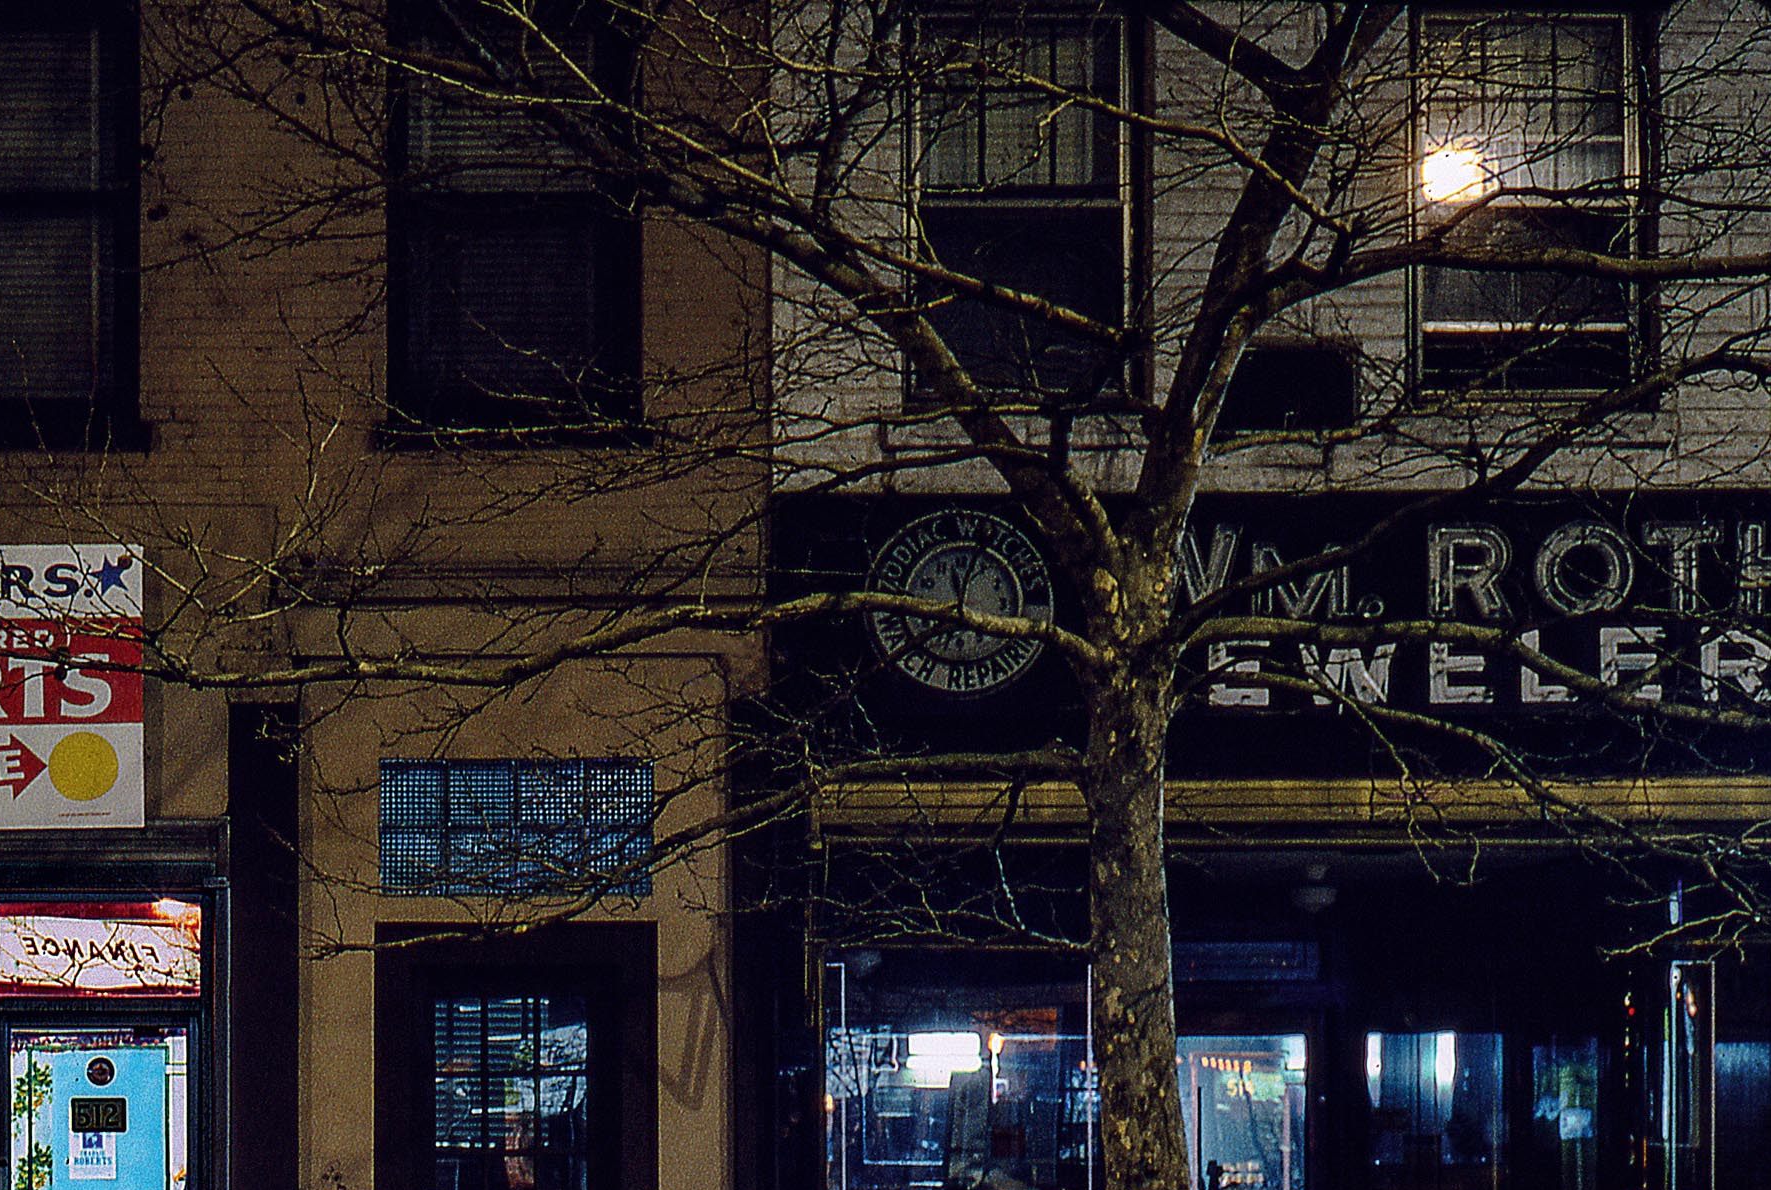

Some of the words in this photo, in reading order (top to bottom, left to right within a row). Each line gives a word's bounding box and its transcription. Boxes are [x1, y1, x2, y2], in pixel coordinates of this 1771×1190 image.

[956, 517, 1045, 590] WTCHES
[872, 611, 932, 685] WACH
[1208, 627, 1771, 705] EWELER
[77, 1103, 120, 1129] 512
